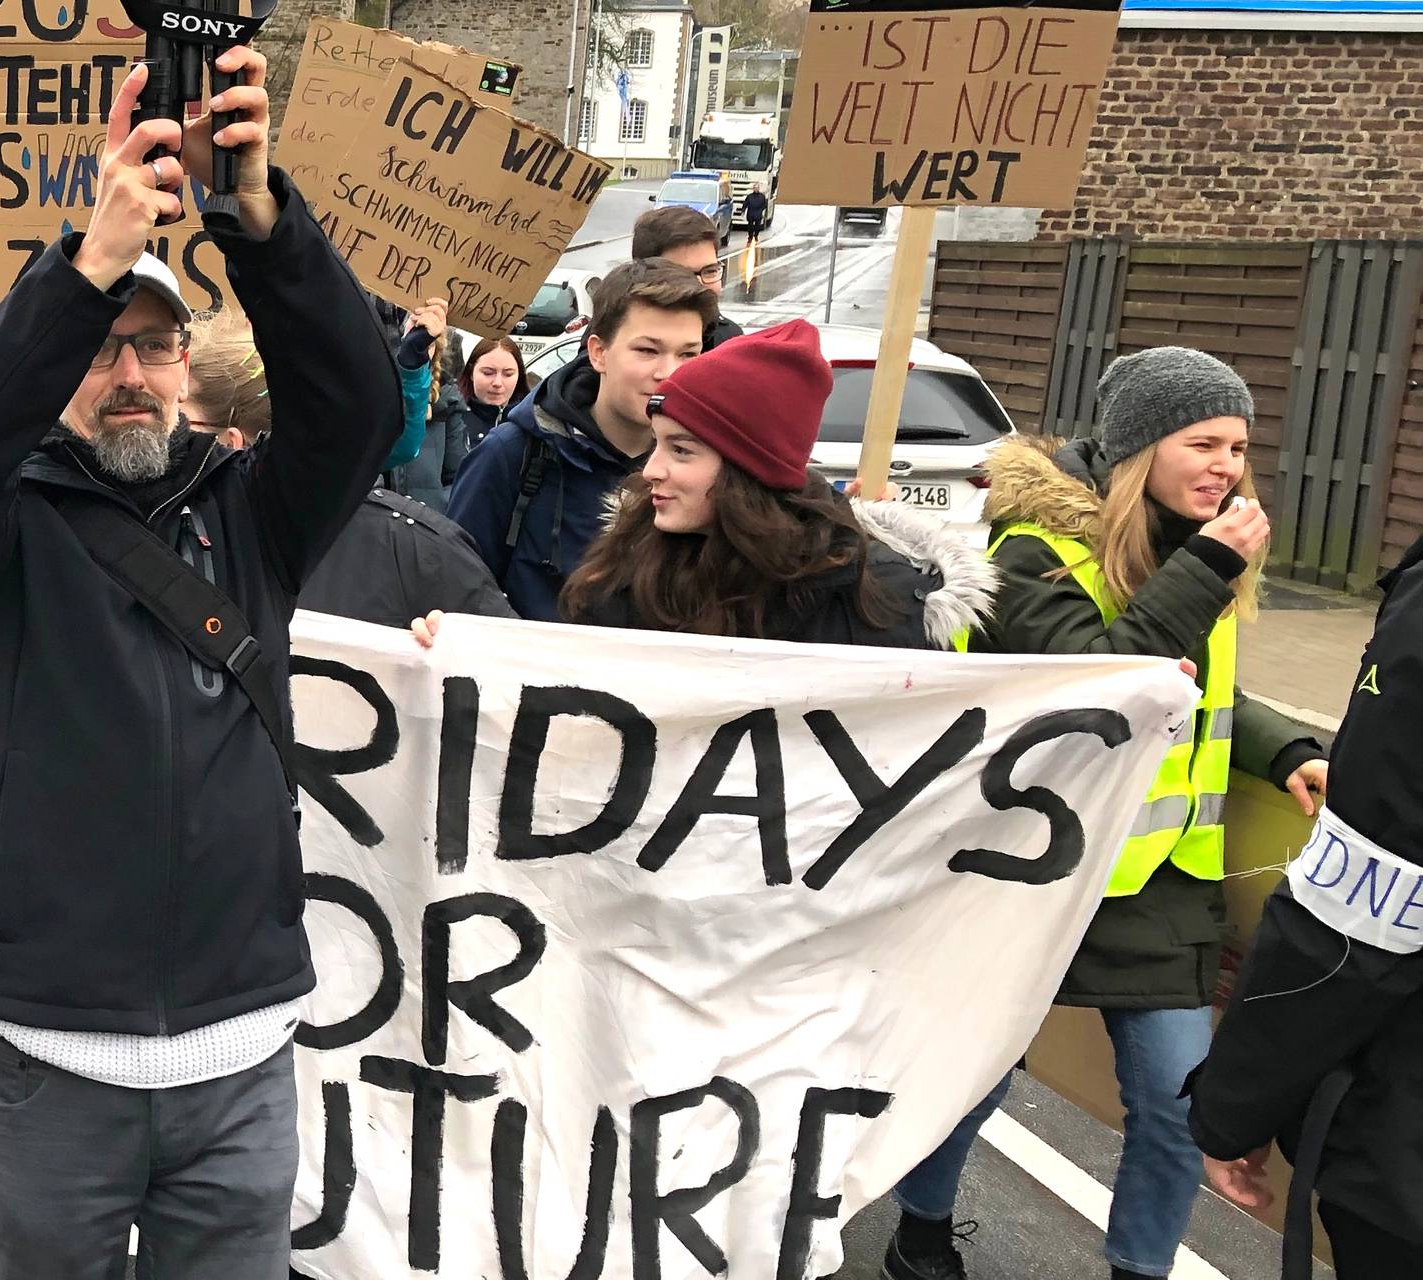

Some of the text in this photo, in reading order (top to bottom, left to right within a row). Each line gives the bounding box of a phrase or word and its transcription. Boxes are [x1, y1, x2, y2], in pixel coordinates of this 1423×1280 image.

[161, 11, 245, 38] SONY
[968, 15, 1075, 76] DIE
[301, 77, 376, 112] Erde
[810, 80, 1102, 148] WELT NICHT
[384, 75, 613, 206] ICH WILL IM
[872, 149, 1021, 206] WERT
[376, 243, 432, 299] DER
[445, 275, 525, 333] STRASSE
[466, 240, 530, 284] NICHT
[900, 486, 949, 506] 2148
[1298, 820, 1423, 932] DNE
